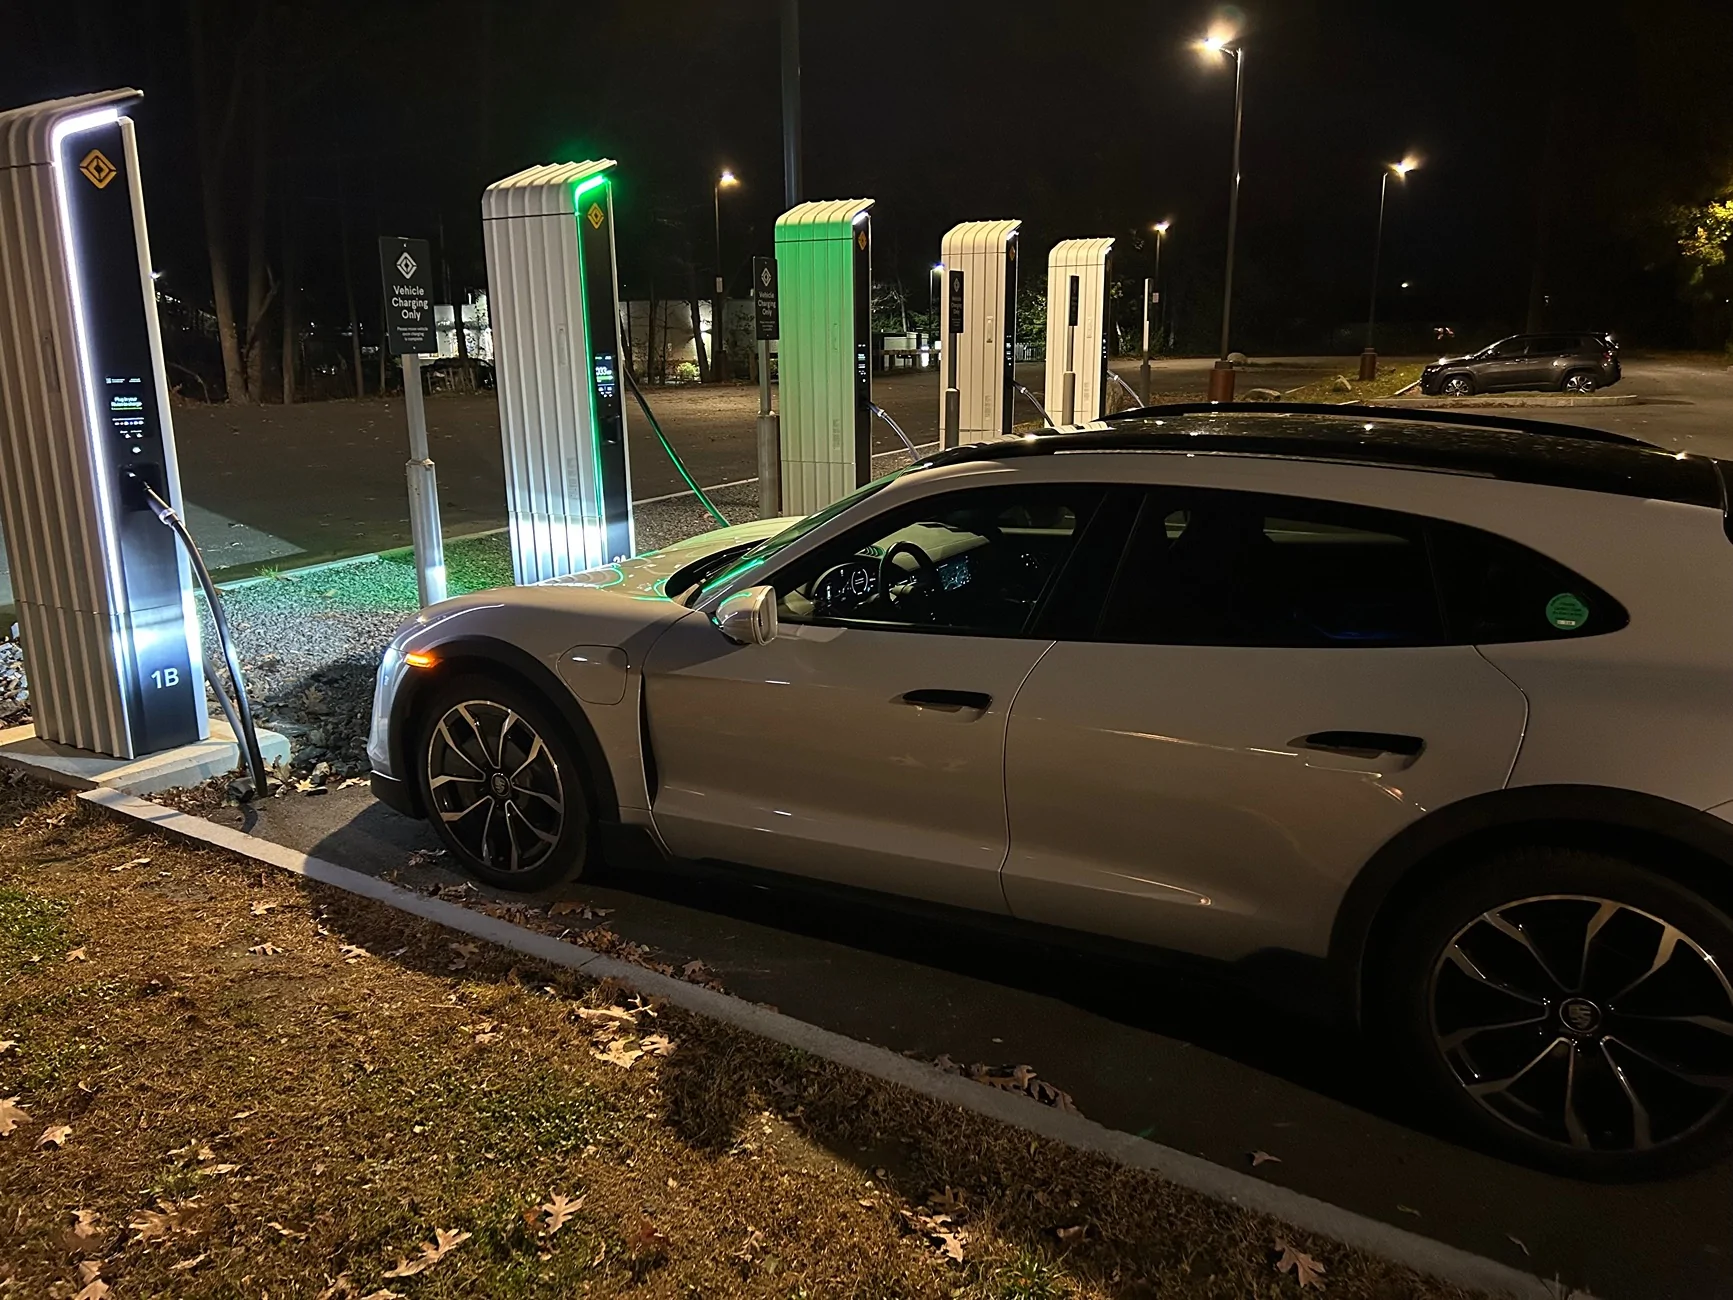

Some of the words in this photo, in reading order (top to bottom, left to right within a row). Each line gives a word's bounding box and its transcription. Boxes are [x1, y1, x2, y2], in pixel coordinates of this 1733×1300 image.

[393, 285, 424, 295] Vehicle
[391, 297, 428, 309] Charging
[758, 300, 776, 308] Charging
[401, 309, 421, 321] Only
[762, 308, 772, 316] Only
[151, 667, 179, 689] 1B
